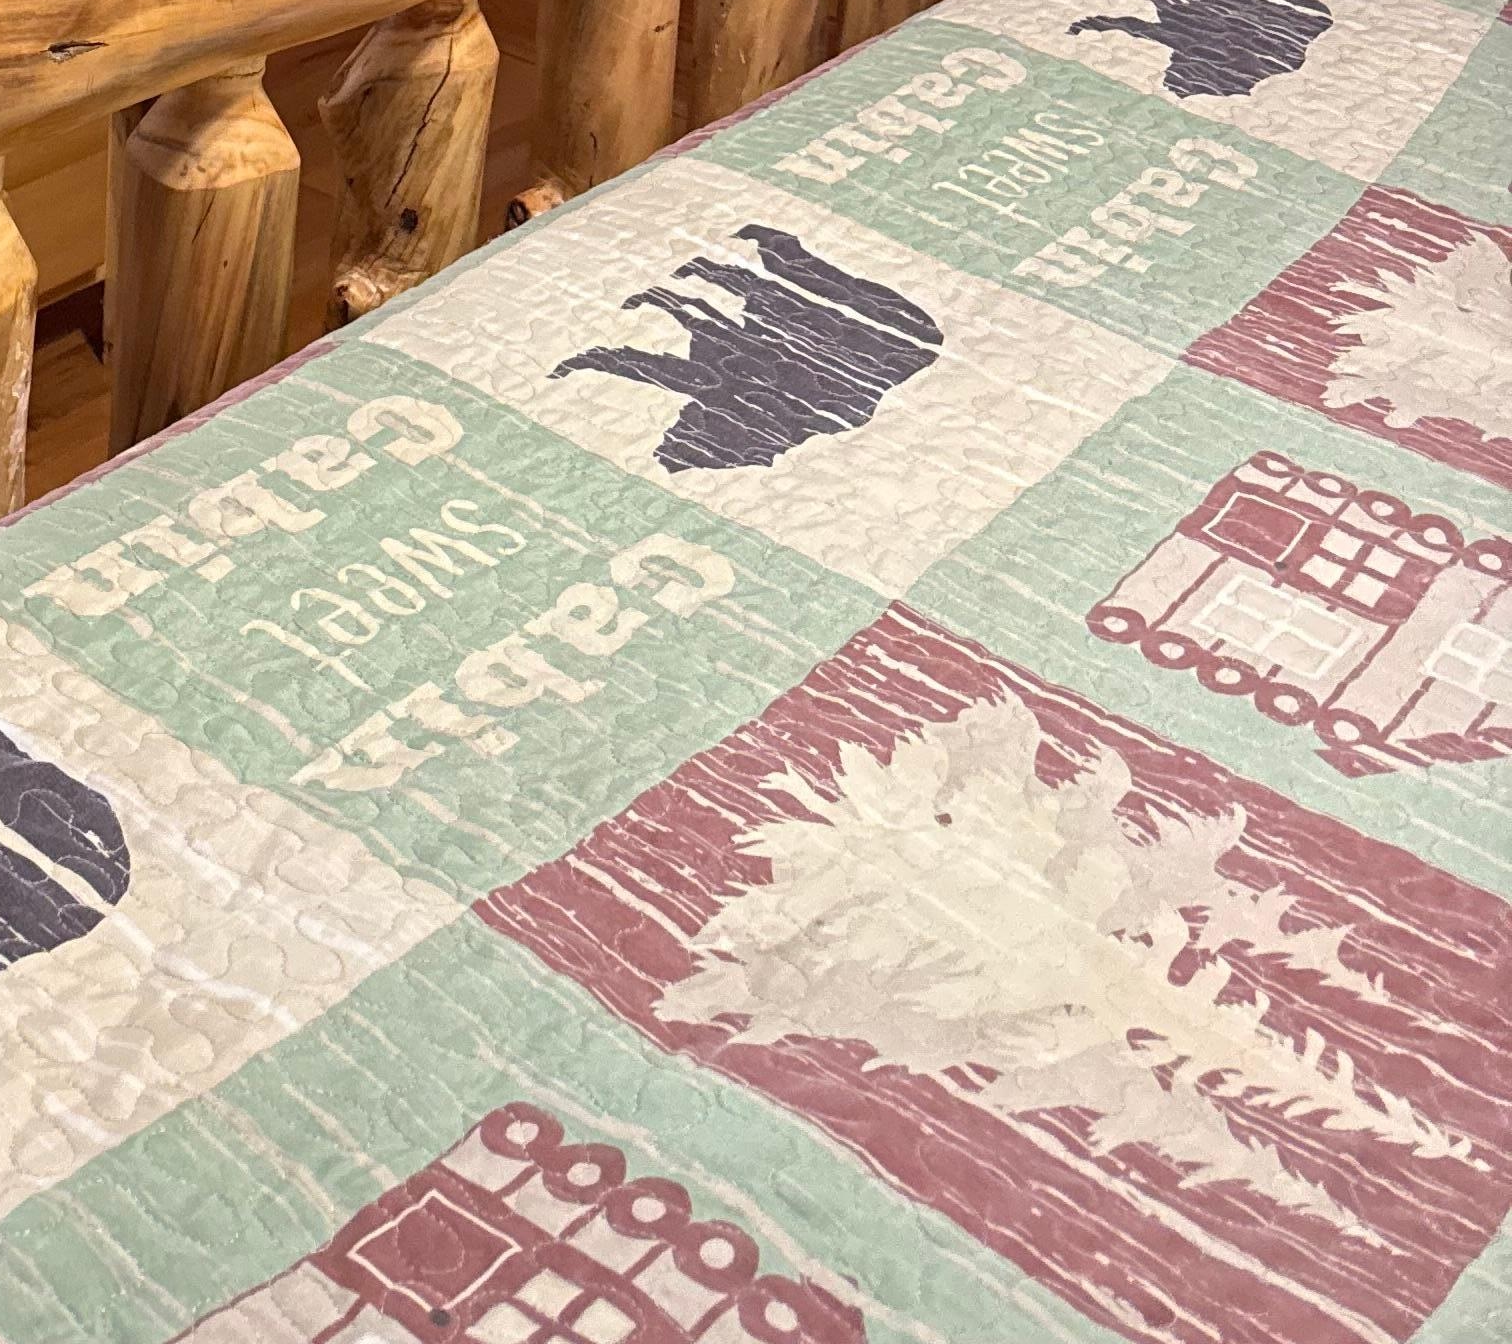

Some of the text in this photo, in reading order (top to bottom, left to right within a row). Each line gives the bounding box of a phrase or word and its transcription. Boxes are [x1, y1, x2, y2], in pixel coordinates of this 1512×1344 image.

[772, 48, 1026, 184] Cabin
[932, 112, 1105, 229] sweet
[1011, 138, 1257, 287] Cabin
[22, 394, 464, 616] Cabin
[240, 499, 527, 672] sweet
[289, 533, 735, 792] Cabin
